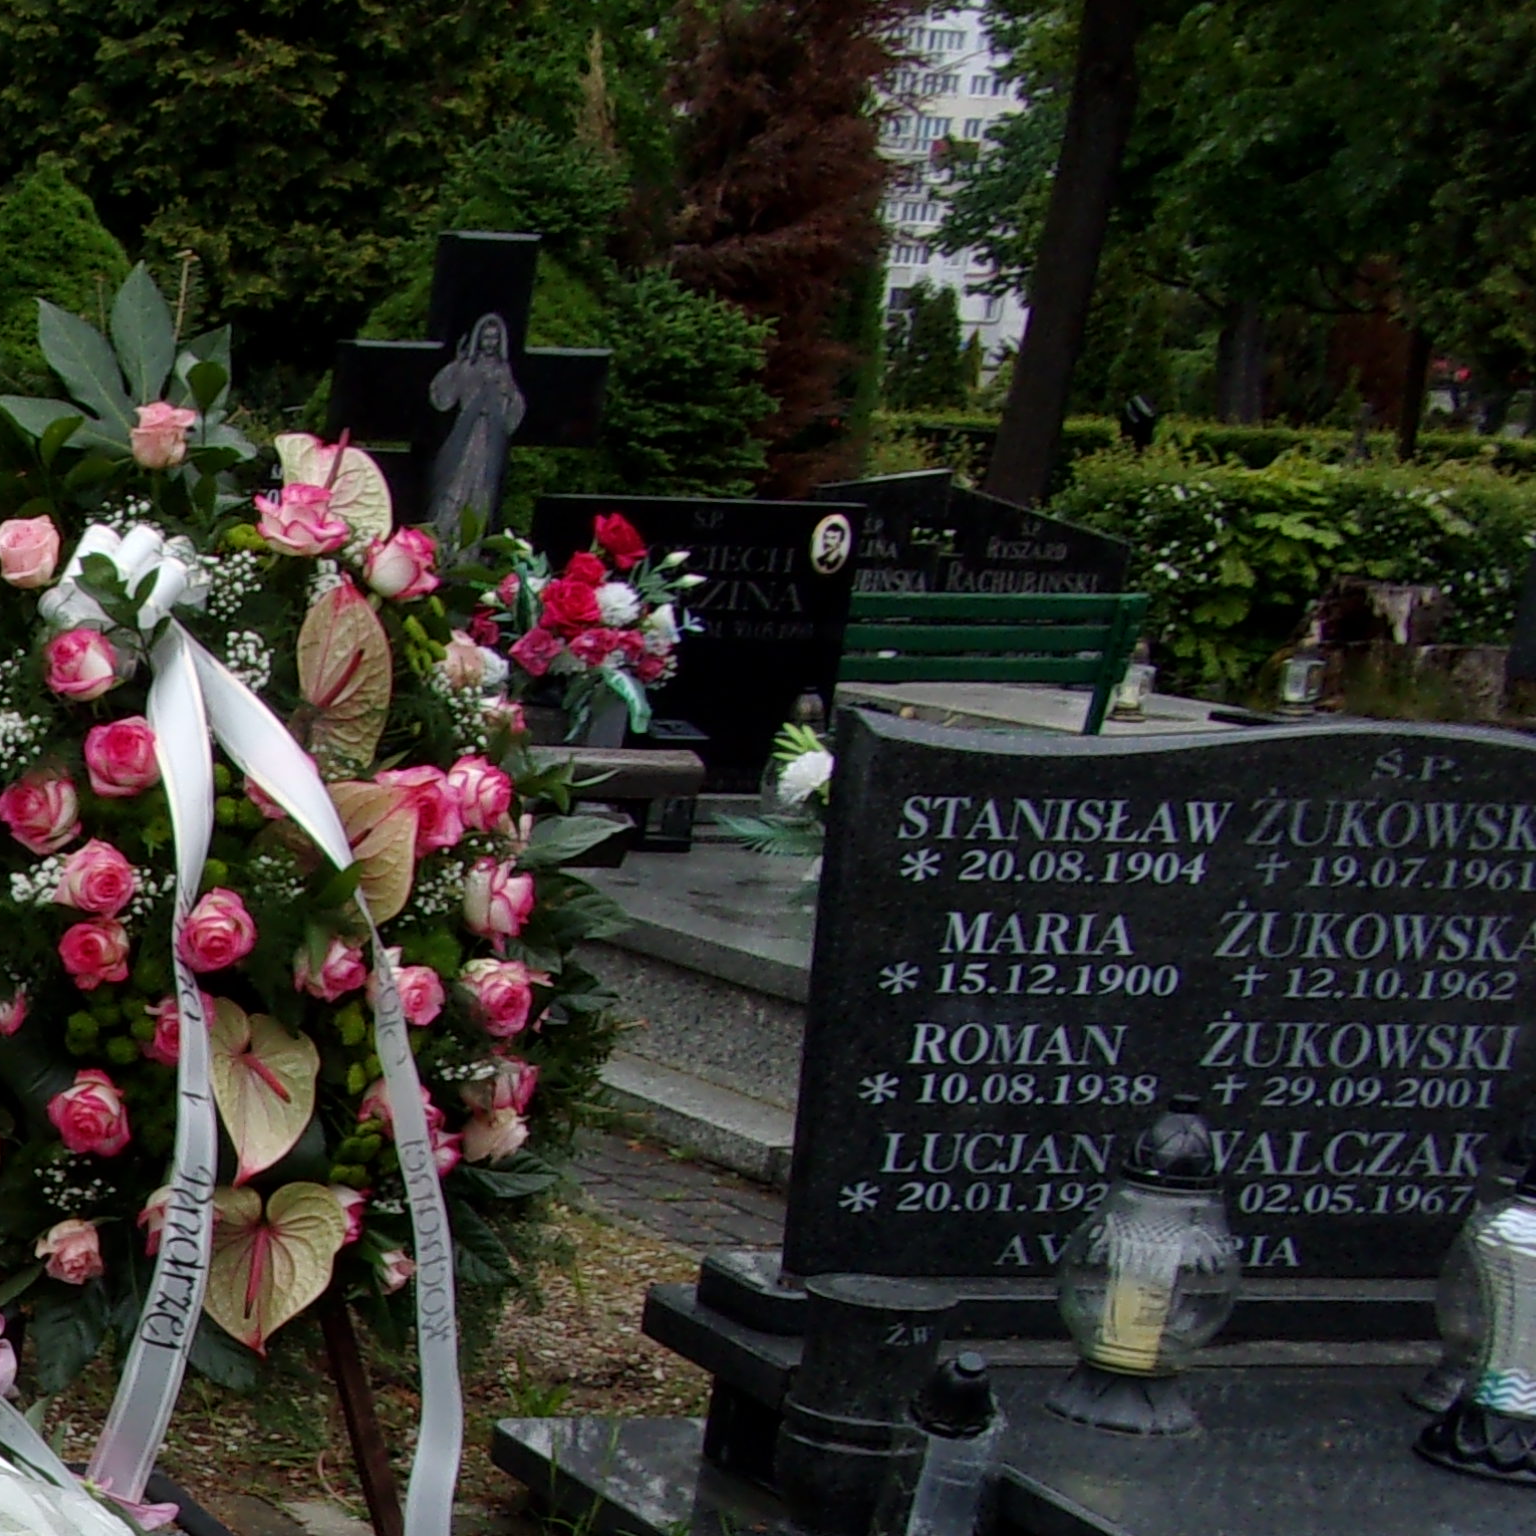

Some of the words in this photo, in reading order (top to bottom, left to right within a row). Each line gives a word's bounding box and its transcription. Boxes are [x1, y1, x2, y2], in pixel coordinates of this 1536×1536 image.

[897, 794, 1235, 845] STANISŁAW
[957, 848, 1209, 885] 20.08.1904
[1304, 853, 1536, 892] 19.07.1961
[937, 910, 1135, 956] MARIA
[933, 961, 1181, 998] 15.12.1900
[1282, 965, 1519, 1001] 12.10.1962
[905, 1022, 1129, 1067] ROMAN
[1198, 1009, 1521, 1072] ŻUKOWSKI
[915, 1072, 1160, 1106] 10.08.1938
[1259, 1075, 1496, 1109] 29.09.2001
[879, 1130, 1116, 1175] LUCJAN
[895, 1181, 1112, 1213] 20.01.192
[1238, 1180, 1476, 1217] 02.05.1967
